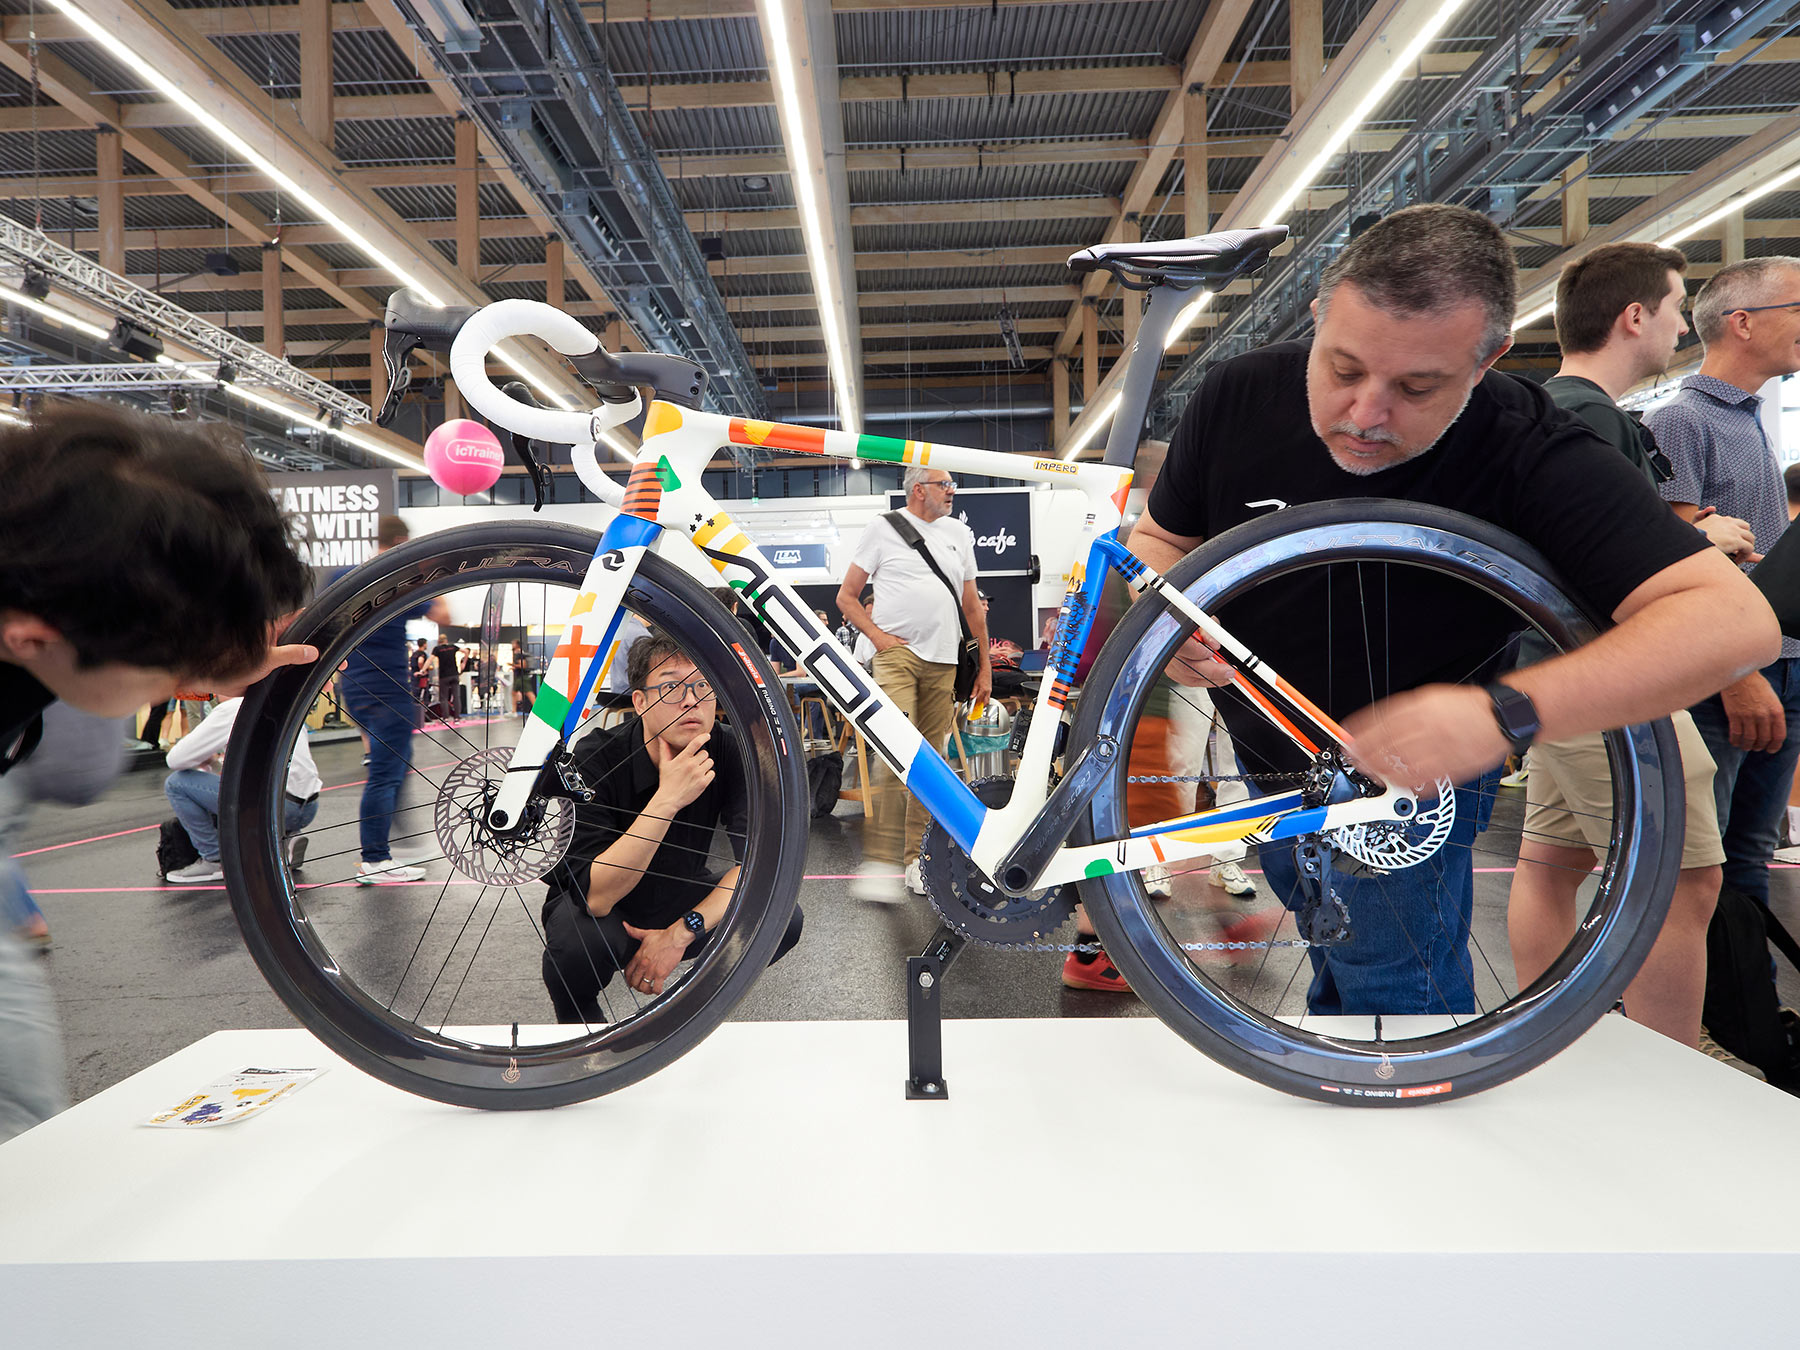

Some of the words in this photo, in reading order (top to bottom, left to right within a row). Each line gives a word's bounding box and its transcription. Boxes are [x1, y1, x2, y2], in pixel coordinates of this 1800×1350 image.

[1035, 462, 1078, 474] IMPERO
[311, 512, 379, 539] WITH
[976, 527, 1017, 555] cafe
[291, 539, 380, 567] ARMIN
[458, 556, 575, 575] ULTRA
[989, 637, 1012, 649] ike
